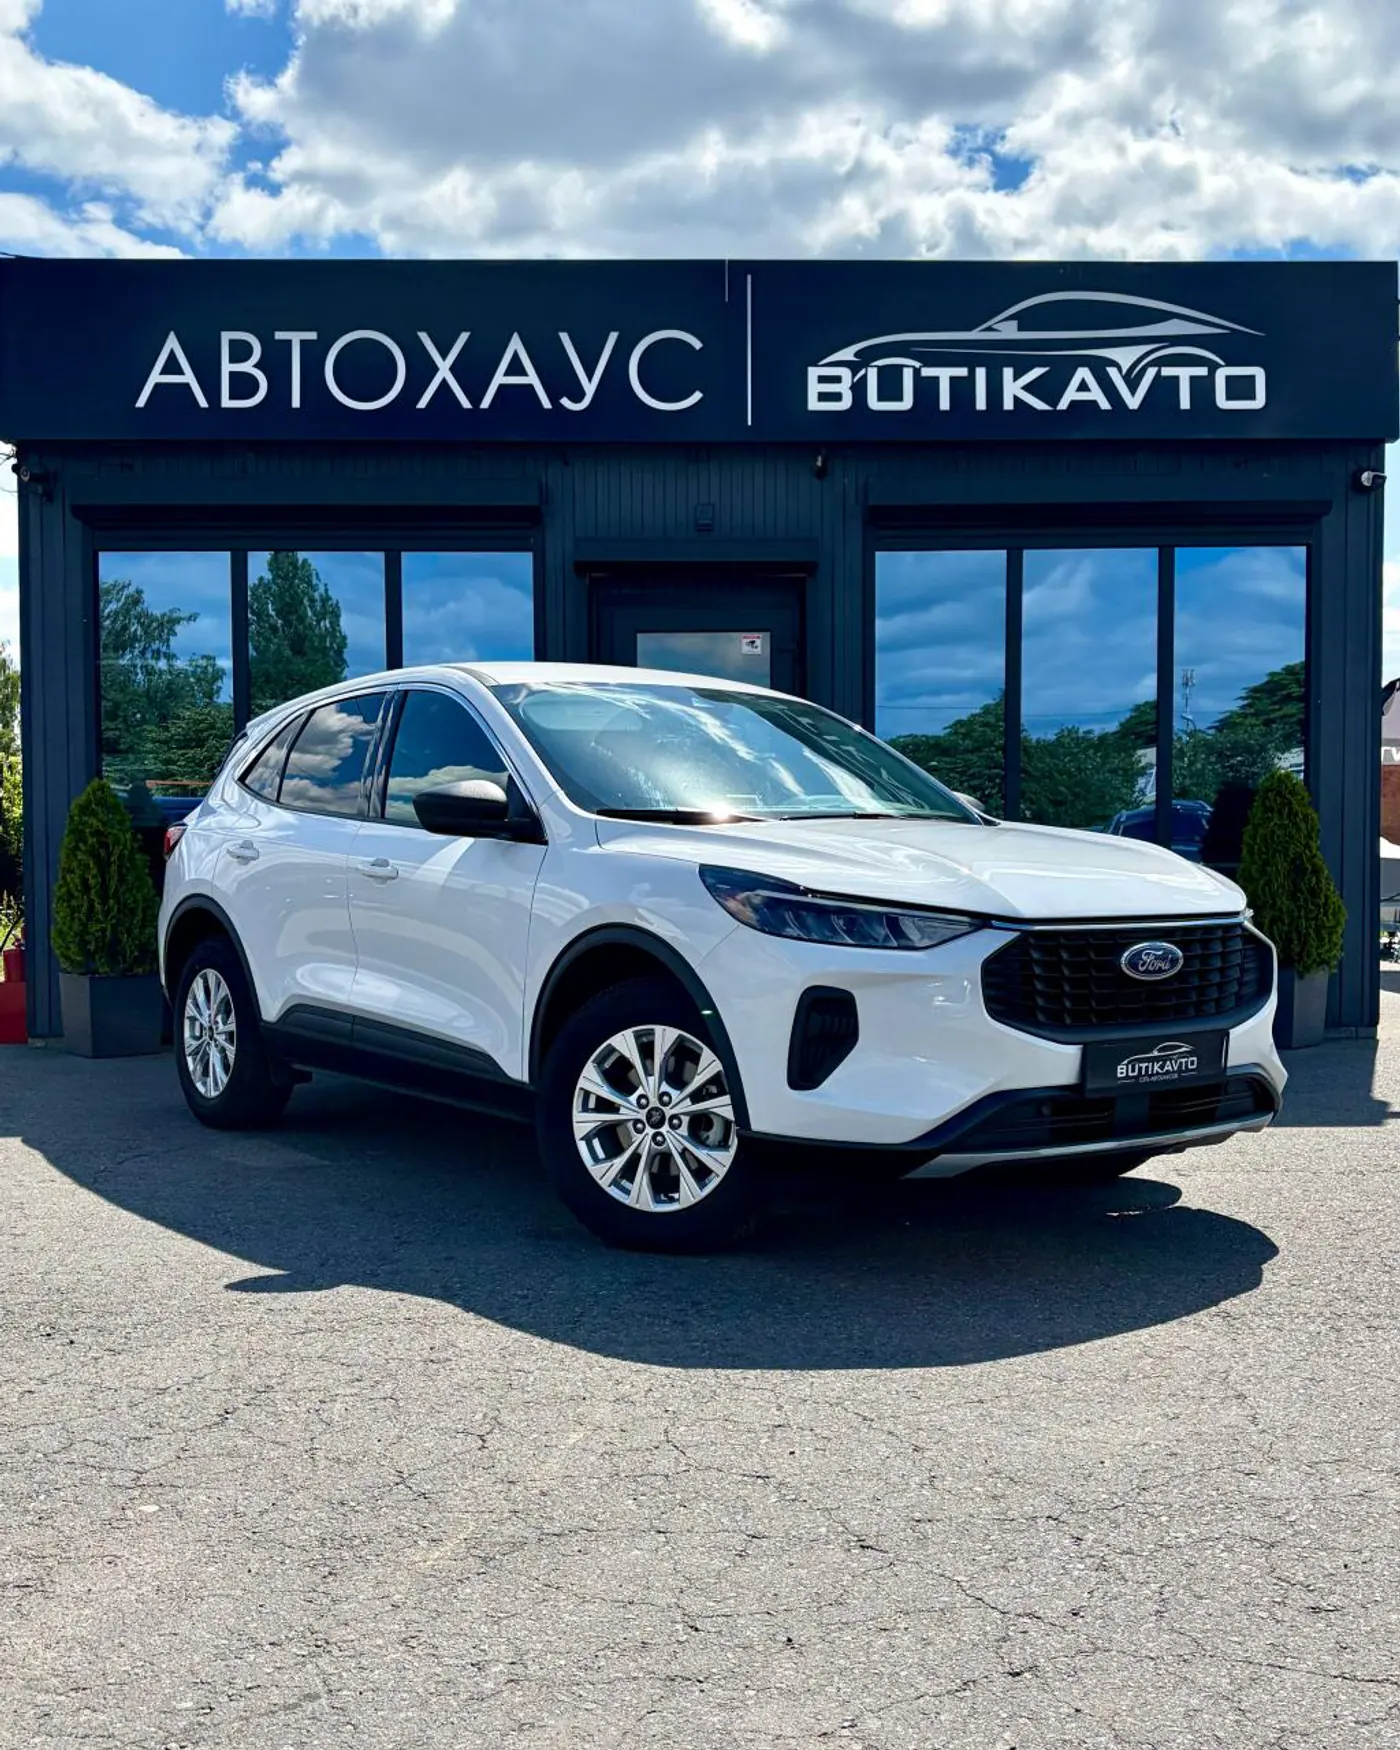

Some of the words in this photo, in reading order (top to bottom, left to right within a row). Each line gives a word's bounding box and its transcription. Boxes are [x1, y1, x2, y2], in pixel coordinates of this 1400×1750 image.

[135, 329, 704, 411] АВТОХАУС
[807, 365, 1266, 411] BUTIKAVTO
[1138, 950, 1172, 972] Ford
[1117, 1057, 1198, 1078] BUTIKAVTO
